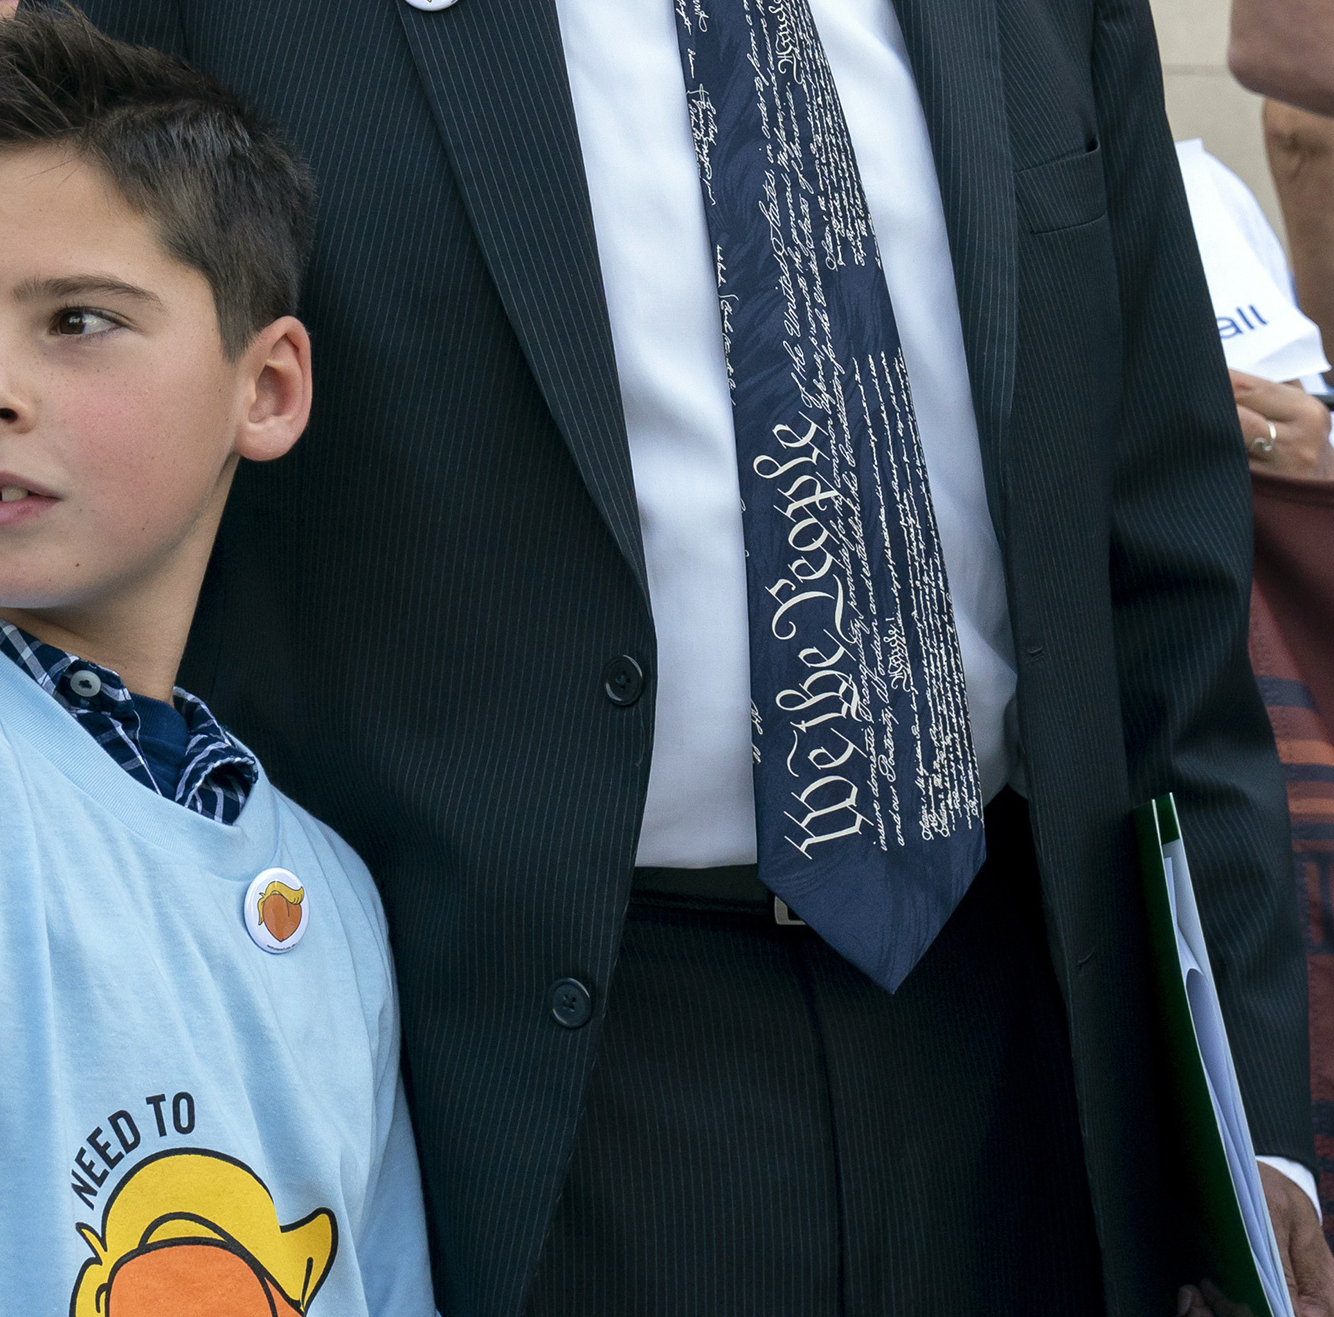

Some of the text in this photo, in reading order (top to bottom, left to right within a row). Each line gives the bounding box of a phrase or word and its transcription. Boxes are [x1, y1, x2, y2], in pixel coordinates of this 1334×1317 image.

[746, 29, 770, 86] form
[758, 143, 774, 163] in
[781, 172, 811, 245] general
[786, 246, 804, 274] the
[803, 249, 828, 306] United
[773, 254, 801, 337] United
[814, 308, 832, 340] the
[782, 340, 807, 380] the
[822, 335, 846, 375] for
[790, 372, 822, 408] of
[826, 417, 843, 490] common
[753, 411, 855, 643] People
[847, 499, 872, 577] establish
[859, 575, 877, 615] and
[869, 618, 886, 676] ordain
[775, 629, 862, 733] the
[860, 726, 880, 797] domestic
[784, 728, 874, 859] We
[890, 785, 900, 811] our
[872, 800, 888, 851] insure
[889, 810, 906, 847] and
[70, 1091, 196, 1211] NEED TO
